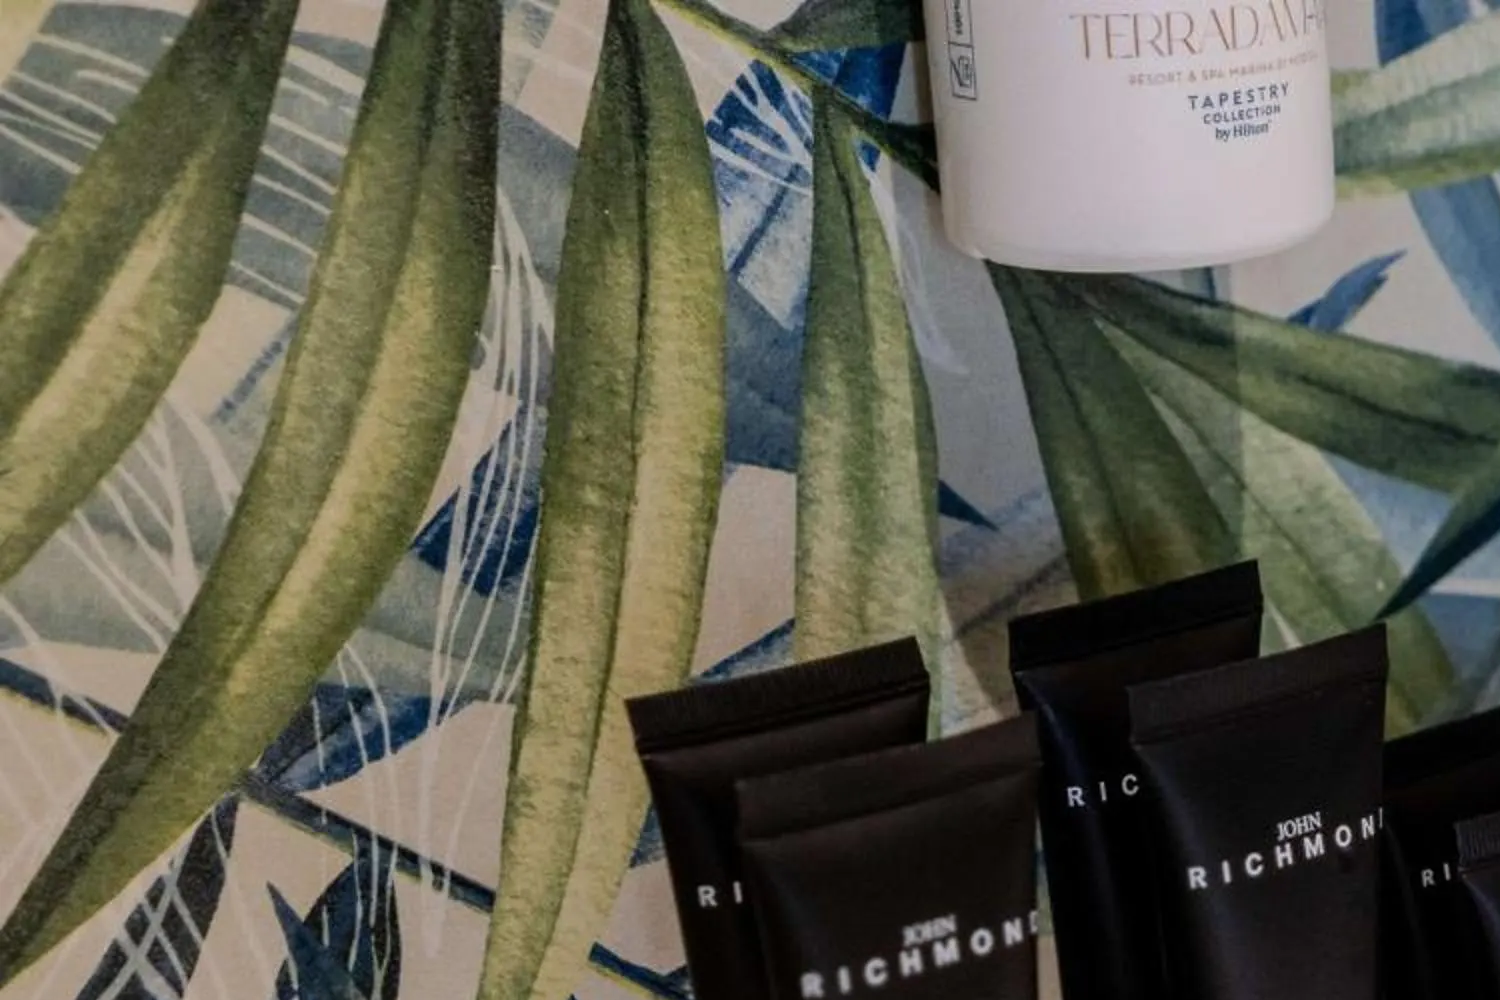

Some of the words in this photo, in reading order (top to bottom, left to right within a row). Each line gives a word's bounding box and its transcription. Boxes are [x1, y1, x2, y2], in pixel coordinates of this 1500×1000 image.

[1187, 82, 1290, 110] TAPESTRY
[1203, 104, 1281, 125] COLLECTION
[1214, 128, 1231, 143] by
[1233, 121, 1269, 139] Hilton
[1276, 811, 1322, 841] JOHN
